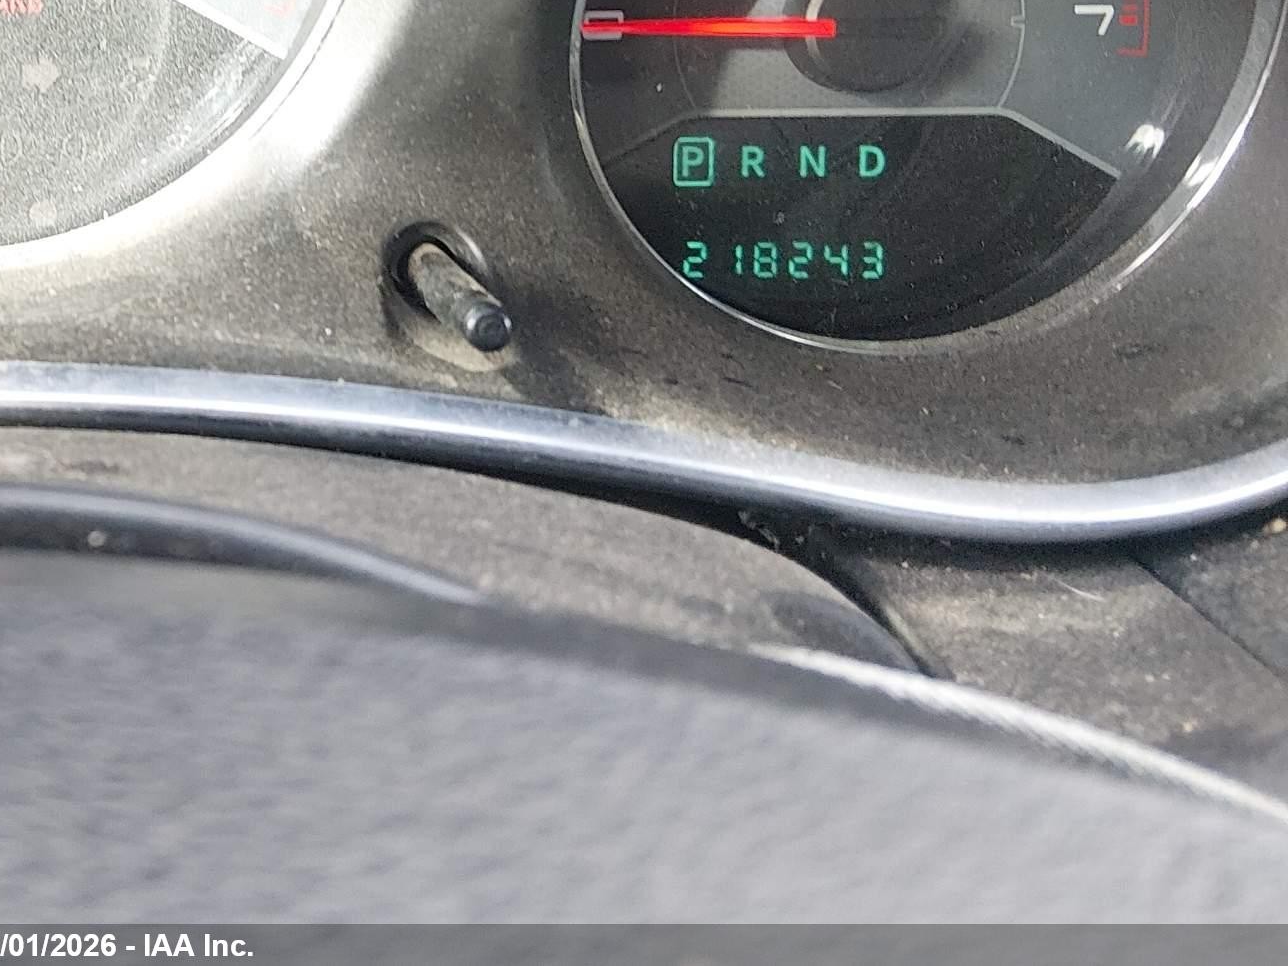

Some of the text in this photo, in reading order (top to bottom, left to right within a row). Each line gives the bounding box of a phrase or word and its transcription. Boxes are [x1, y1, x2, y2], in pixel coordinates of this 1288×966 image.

[1073, 3, 1115, 36] 7
[680, 144, 886, 178] P R N D
[681, 240, 885, 280] 218243
